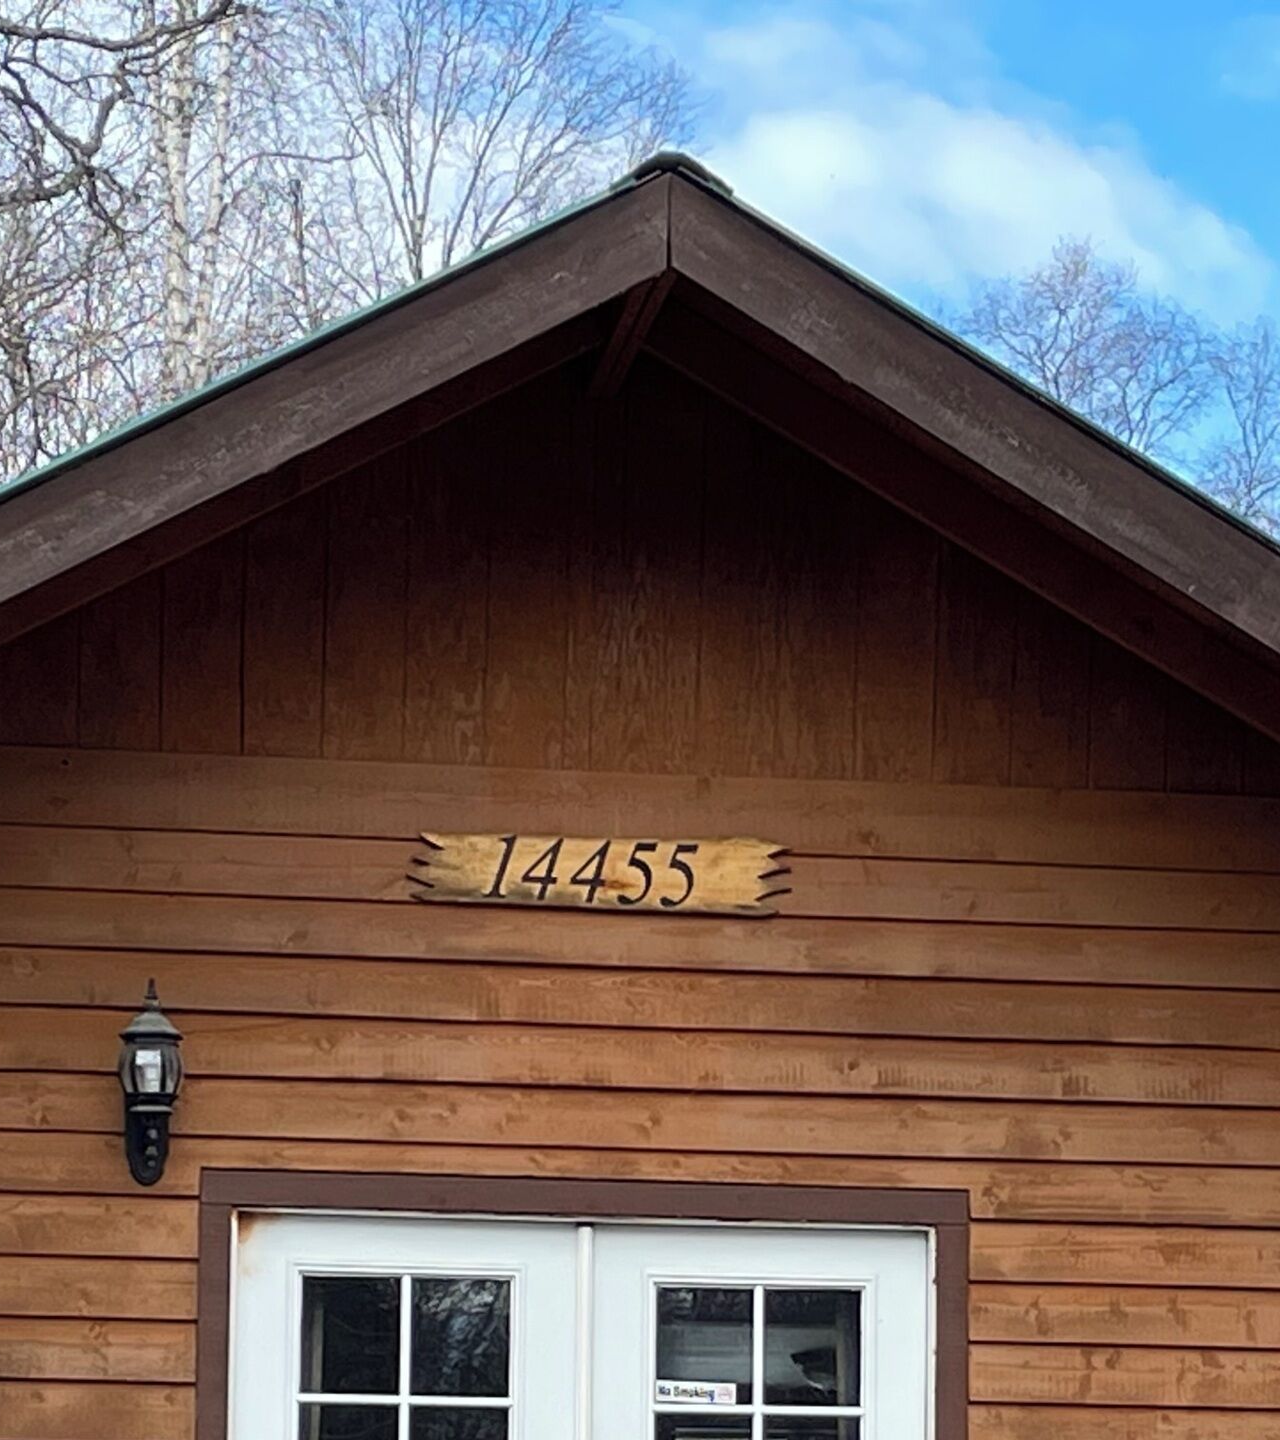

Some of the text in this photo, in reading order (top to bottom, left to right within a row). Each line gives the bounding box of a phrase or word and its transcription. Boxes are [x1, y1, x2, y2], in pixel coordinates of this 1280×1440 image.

[482, 834, 699, 907] 14455
[658, 1385, 716, 1402] No Smoking
